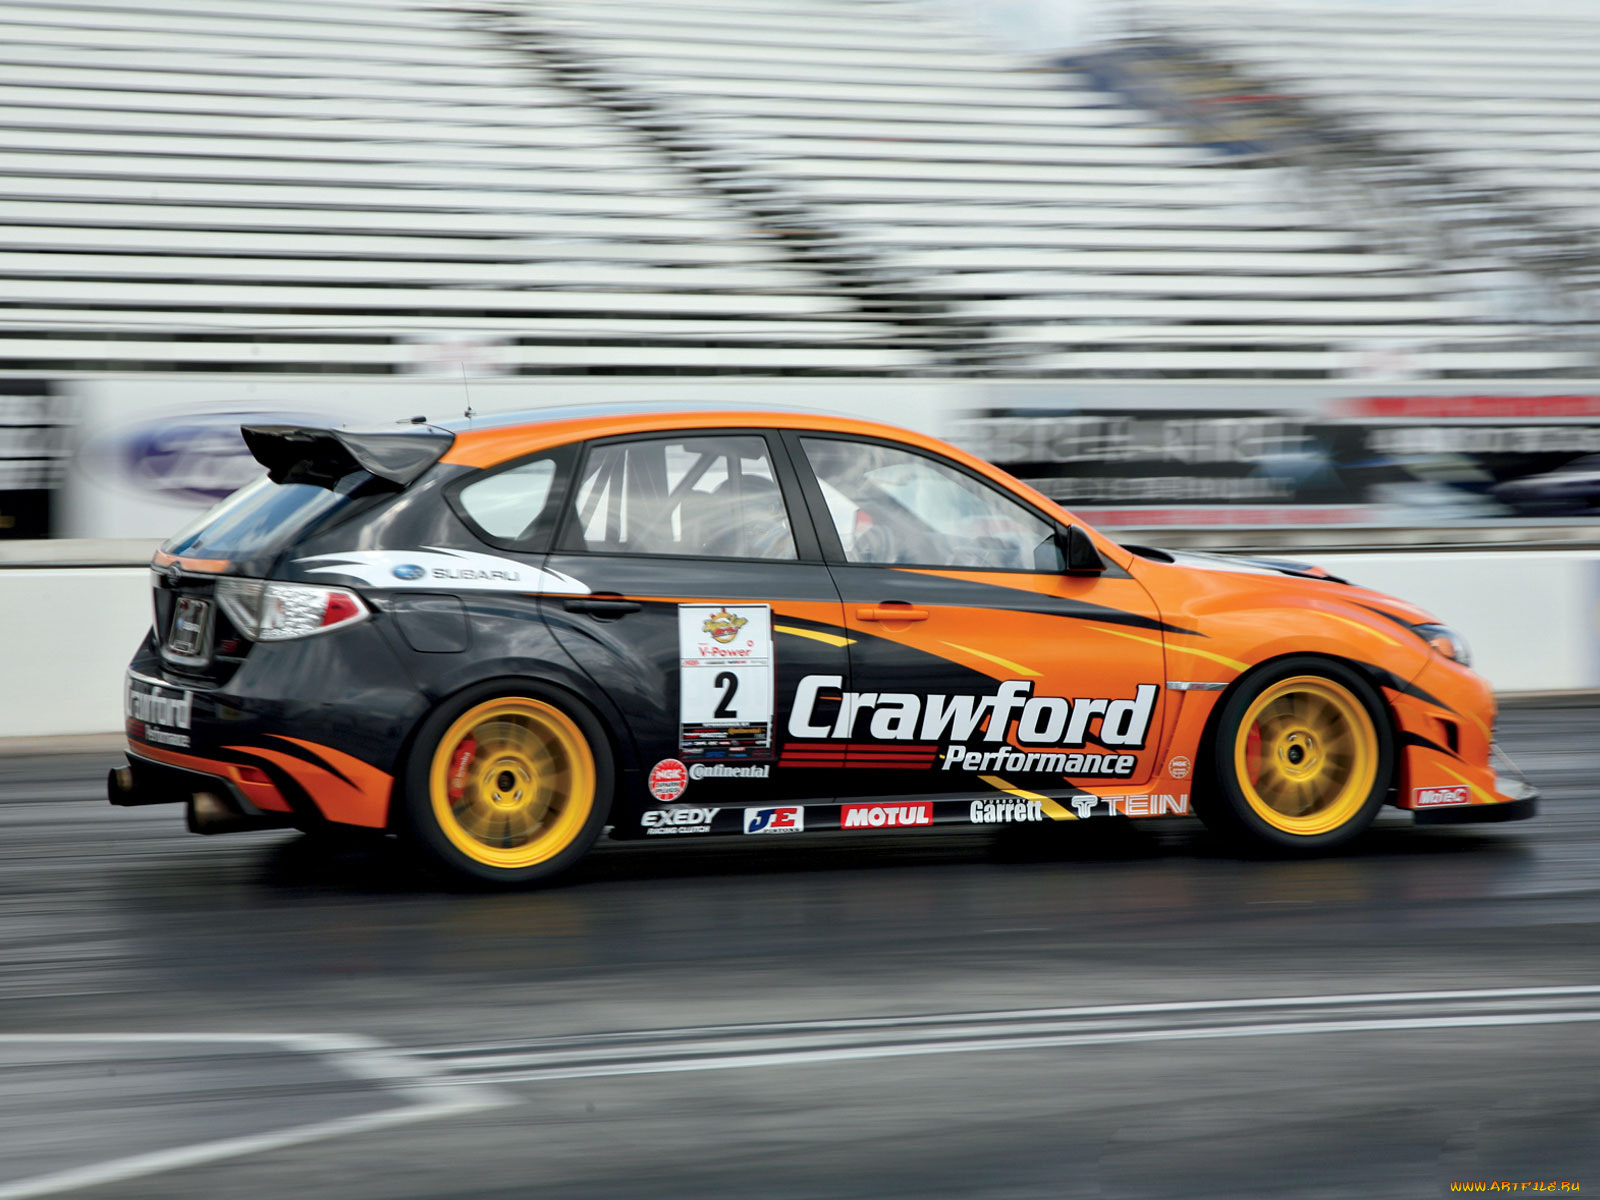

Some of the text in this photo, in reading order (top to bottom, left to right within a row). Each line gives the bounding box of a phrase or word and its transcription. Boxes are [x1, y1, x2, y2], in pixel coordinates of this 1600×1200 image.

[432, 568, 520, 582] SUBARU
[698, 646, 752, 657] V-Power
[714, 671, 739, 719] 2
[788, 675, 1160, 746] Crawford
[940, 745, 1136, 775] Performance
[656, 769, 682, 780] NGK
[688, 763, 771, 780] Continental
[970, 800, 1043, 824] Garrett
[1101, 794, 1188, 816] TEIN
[641, 807, 721, 827] EXEDY
[748, 807, 798, 833] JE
[844, 806, 930, 827] MOTUL
